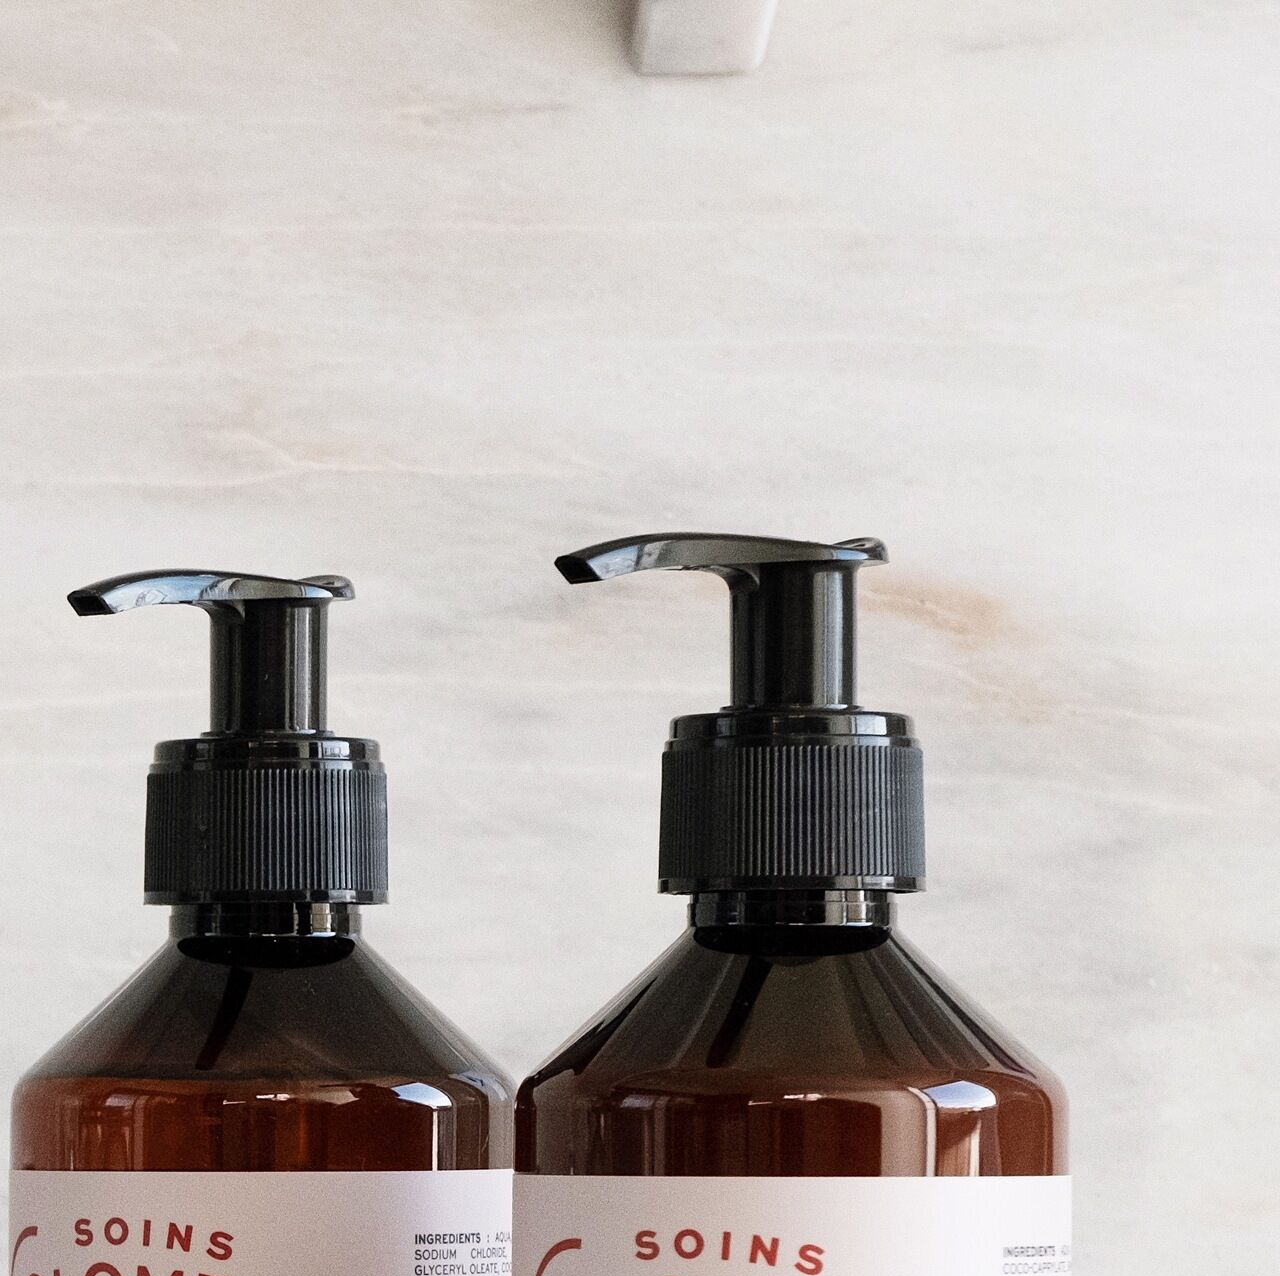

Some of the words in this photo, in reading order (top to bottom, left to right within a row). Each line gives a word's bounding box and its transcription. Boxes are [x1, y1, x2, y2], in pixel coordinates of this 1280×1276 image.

[74, 1217, 234, 1260] SOINS
[414, 1233, 481, 1245] INGREDIENTS
[414, 1249, 457, 1260] SODIUM
[635, 1228, 826, 1276] SOINS
[1003, 1245, 1056, 1257] INGREDIENTS
[414, 1264, 467, 1276] GLYCERYL
